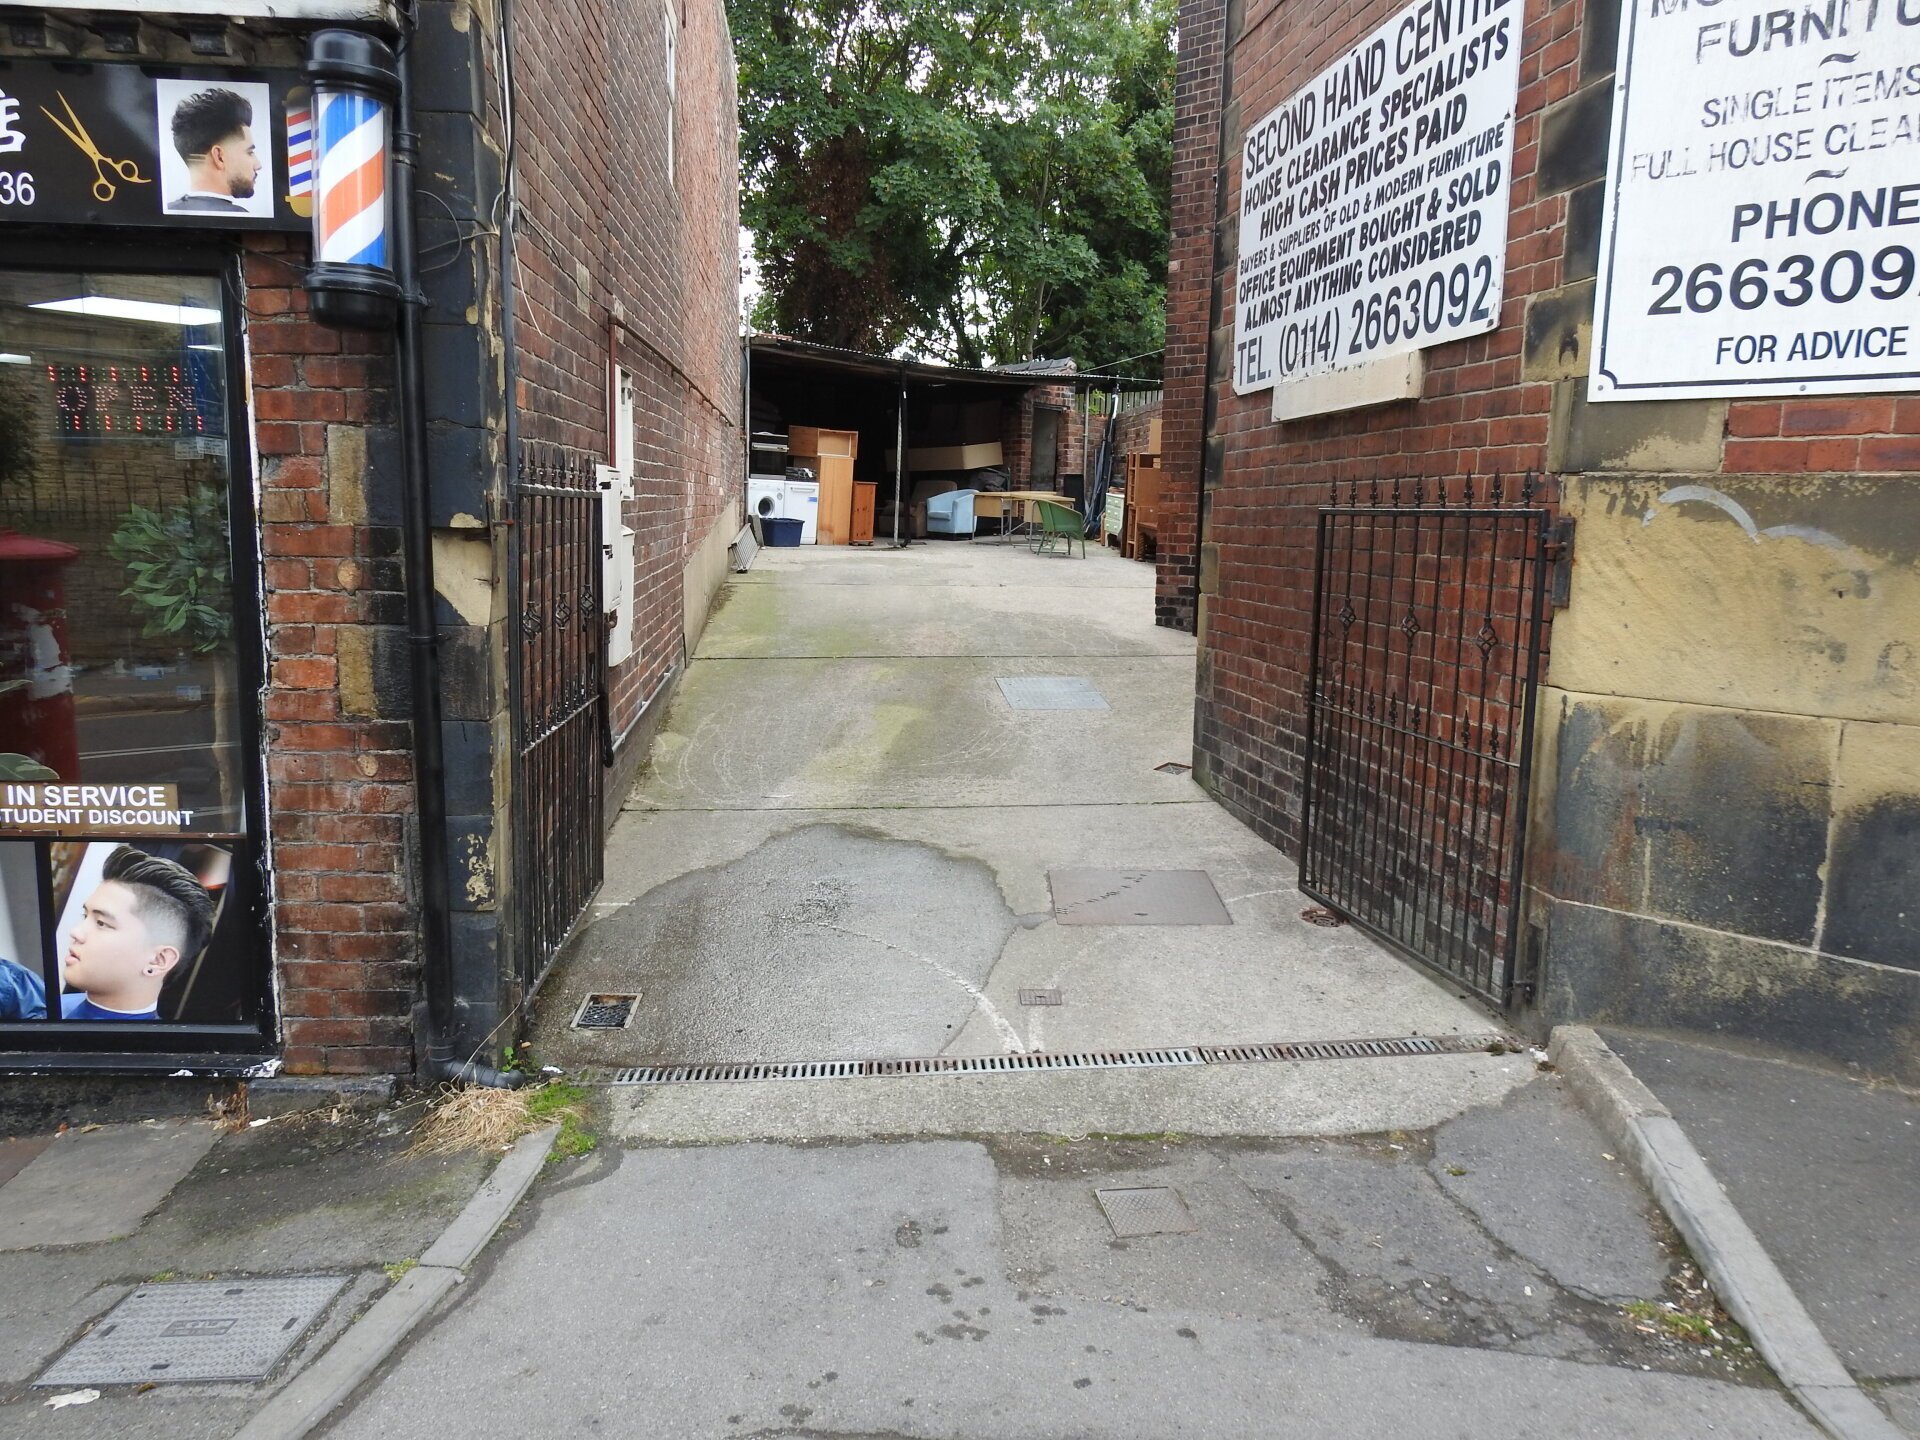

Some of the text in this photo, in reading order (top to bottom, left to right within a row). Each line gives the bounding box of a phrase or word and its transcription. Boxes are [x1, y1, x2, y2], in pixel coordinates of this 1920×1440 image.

[1244, 17, 1509, 217] HOUSE CLEARANCE SPECIALISTS
[1246, 0, 1511, 180] SECOND HAND CENT
[1701, 63, 1920, 128] SINGLE ITEMS
[1260, 93, 1467, 242] HIGH CASH PRICES PAID
[1630, 113, 1920, 183] FULL HOUSE CLEA
[1239, 159, 1501, 304] OFFICE EQUIPMENT BOUGHT & SOLD
[1240, 121, 1505, 276] BUYERS & SUPPLIERS OF OLD & MODERN FURNITURE
[1730, 183, 1920, 243] PHONE
[1244, 209, 1482, 333] ALMOST ANYTHING CONSIDERED
[1647, 245, 1920, 316] 266309
[1237, 254, 1492, 386] TEL. (0114) 2663092
[1715, 325, 1909, 366] FOR ADVICE
[56, 386, 197, 412] OPEN
[7, 785, 167, 807] IN SERVICE
[88, 809, 194, 826] DISCOUNT
